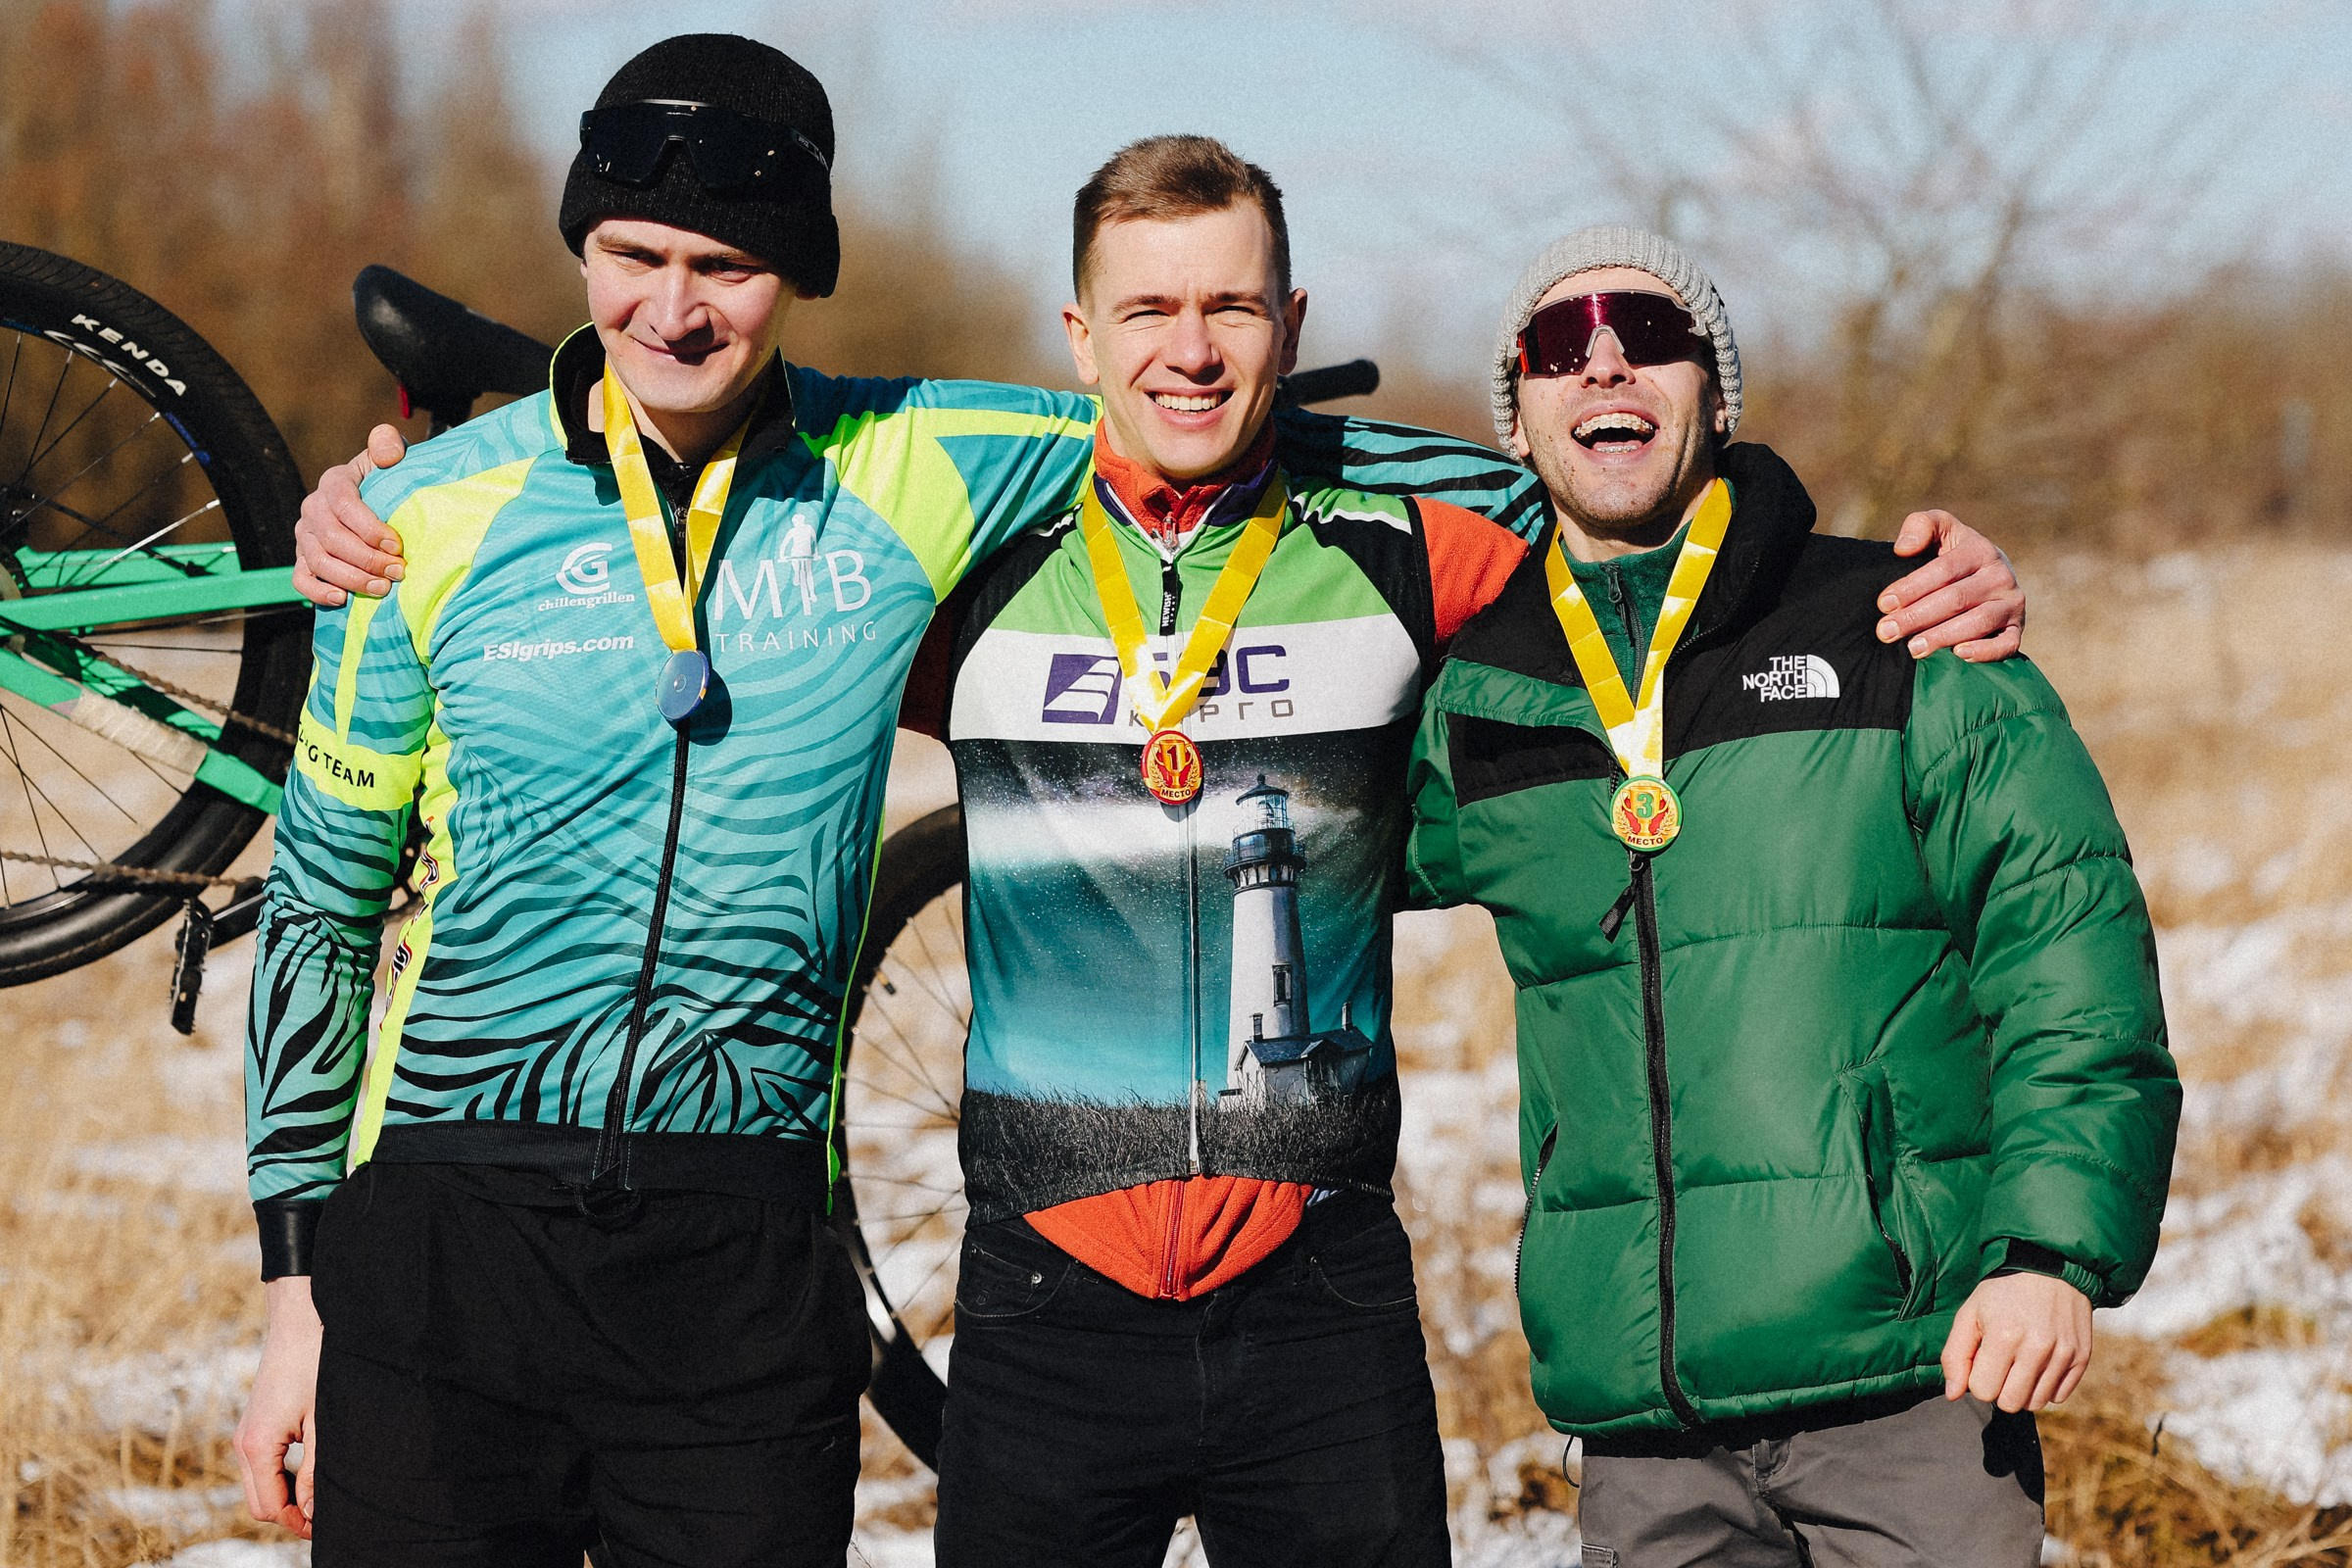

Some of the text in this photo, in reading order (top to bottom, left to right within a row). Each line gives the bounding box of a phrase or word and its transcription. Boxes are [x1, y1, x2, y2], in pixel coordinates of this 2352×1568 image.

[71, 313, 186, 397] KENDA
[537, 591, 635, 612] chillengrillen
[482, 635, 634, 662] ESIgrips.com
[714, 620, 877, 653] TRAINING
[1769, 655, 1807, 671] THE
[1741, 668, 1807, 691] NORTH
[1760, 684, 1807, 703] FACE
[1128, 699, 1295, 727] КРГО
[322, 752, 374, 789] TEAM
[1166, 744, 1179, 771] 1
[1637, 792, 1654, 819] 3
[1627, 835, 1664, 846] МЕСТО
